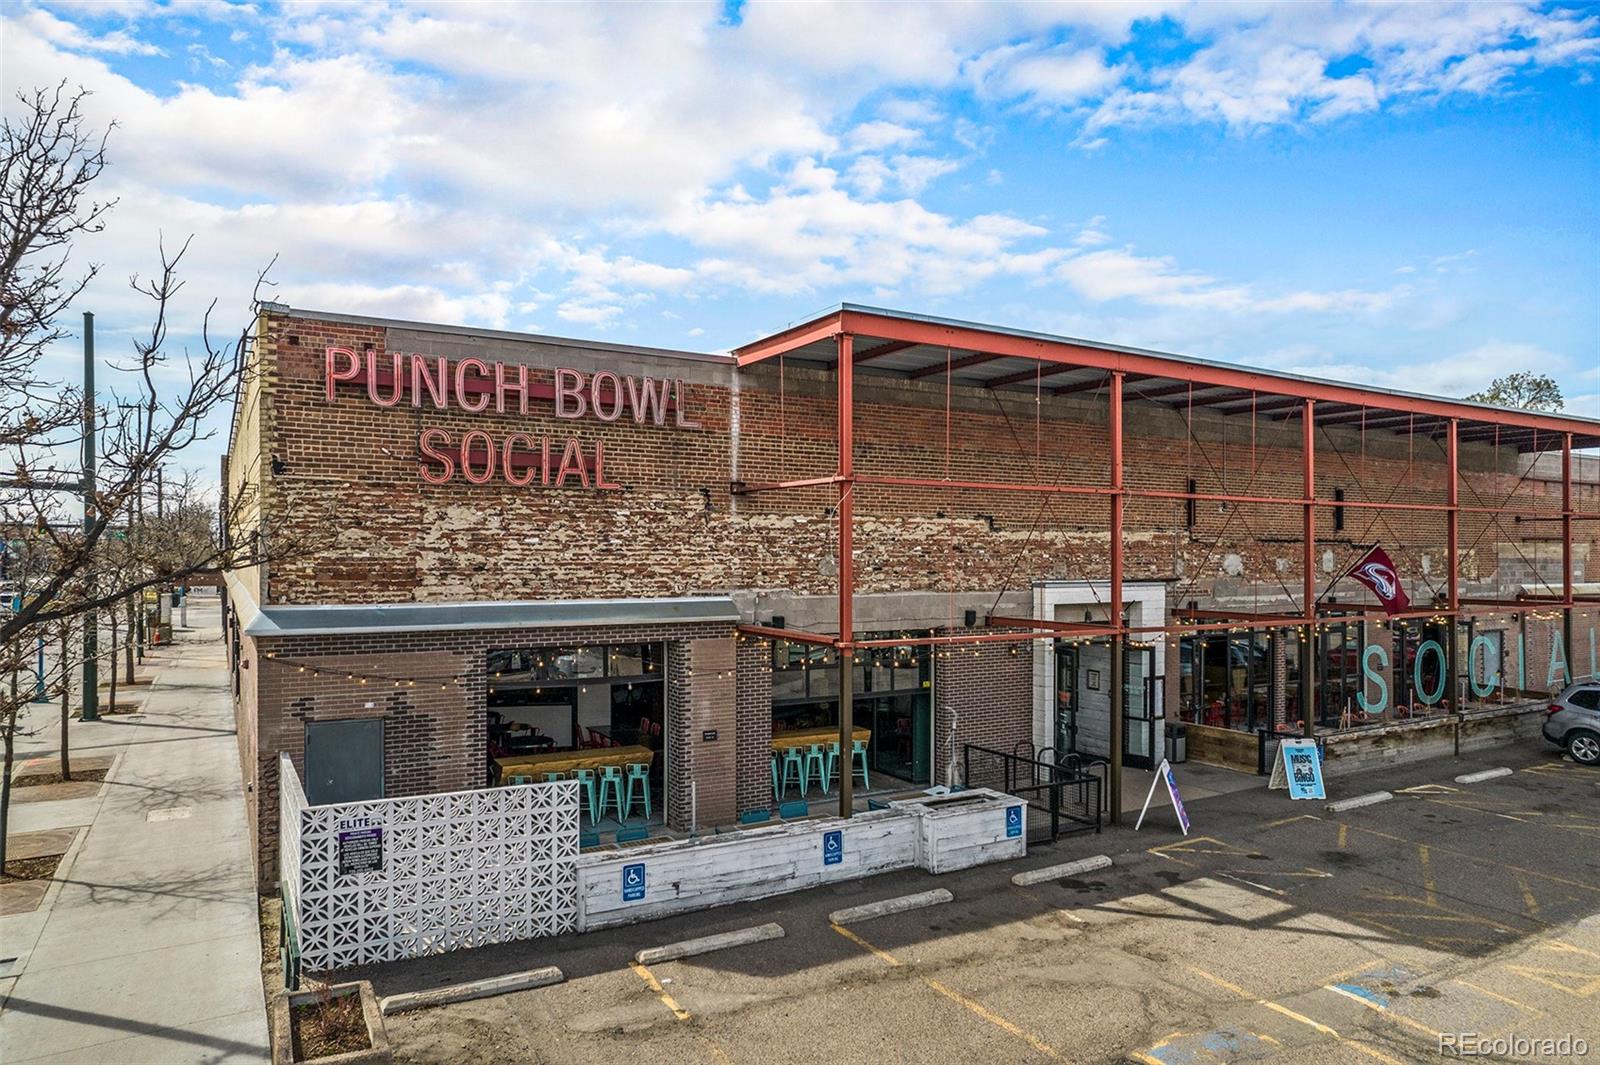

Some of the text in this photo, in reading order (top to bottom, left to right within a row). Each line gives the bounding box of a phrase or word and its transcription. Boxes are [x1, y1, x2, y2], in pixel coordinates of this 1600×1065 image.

[325, 345, 701, 428] PUNCH BOWL
[419, 428, 621, 490] SOCIAL
[1356, 627, 1600, 714] SOCIAL
[1290, 754, 1312, 764] MUSIC
[340, 817, 370, 829] ELITE
